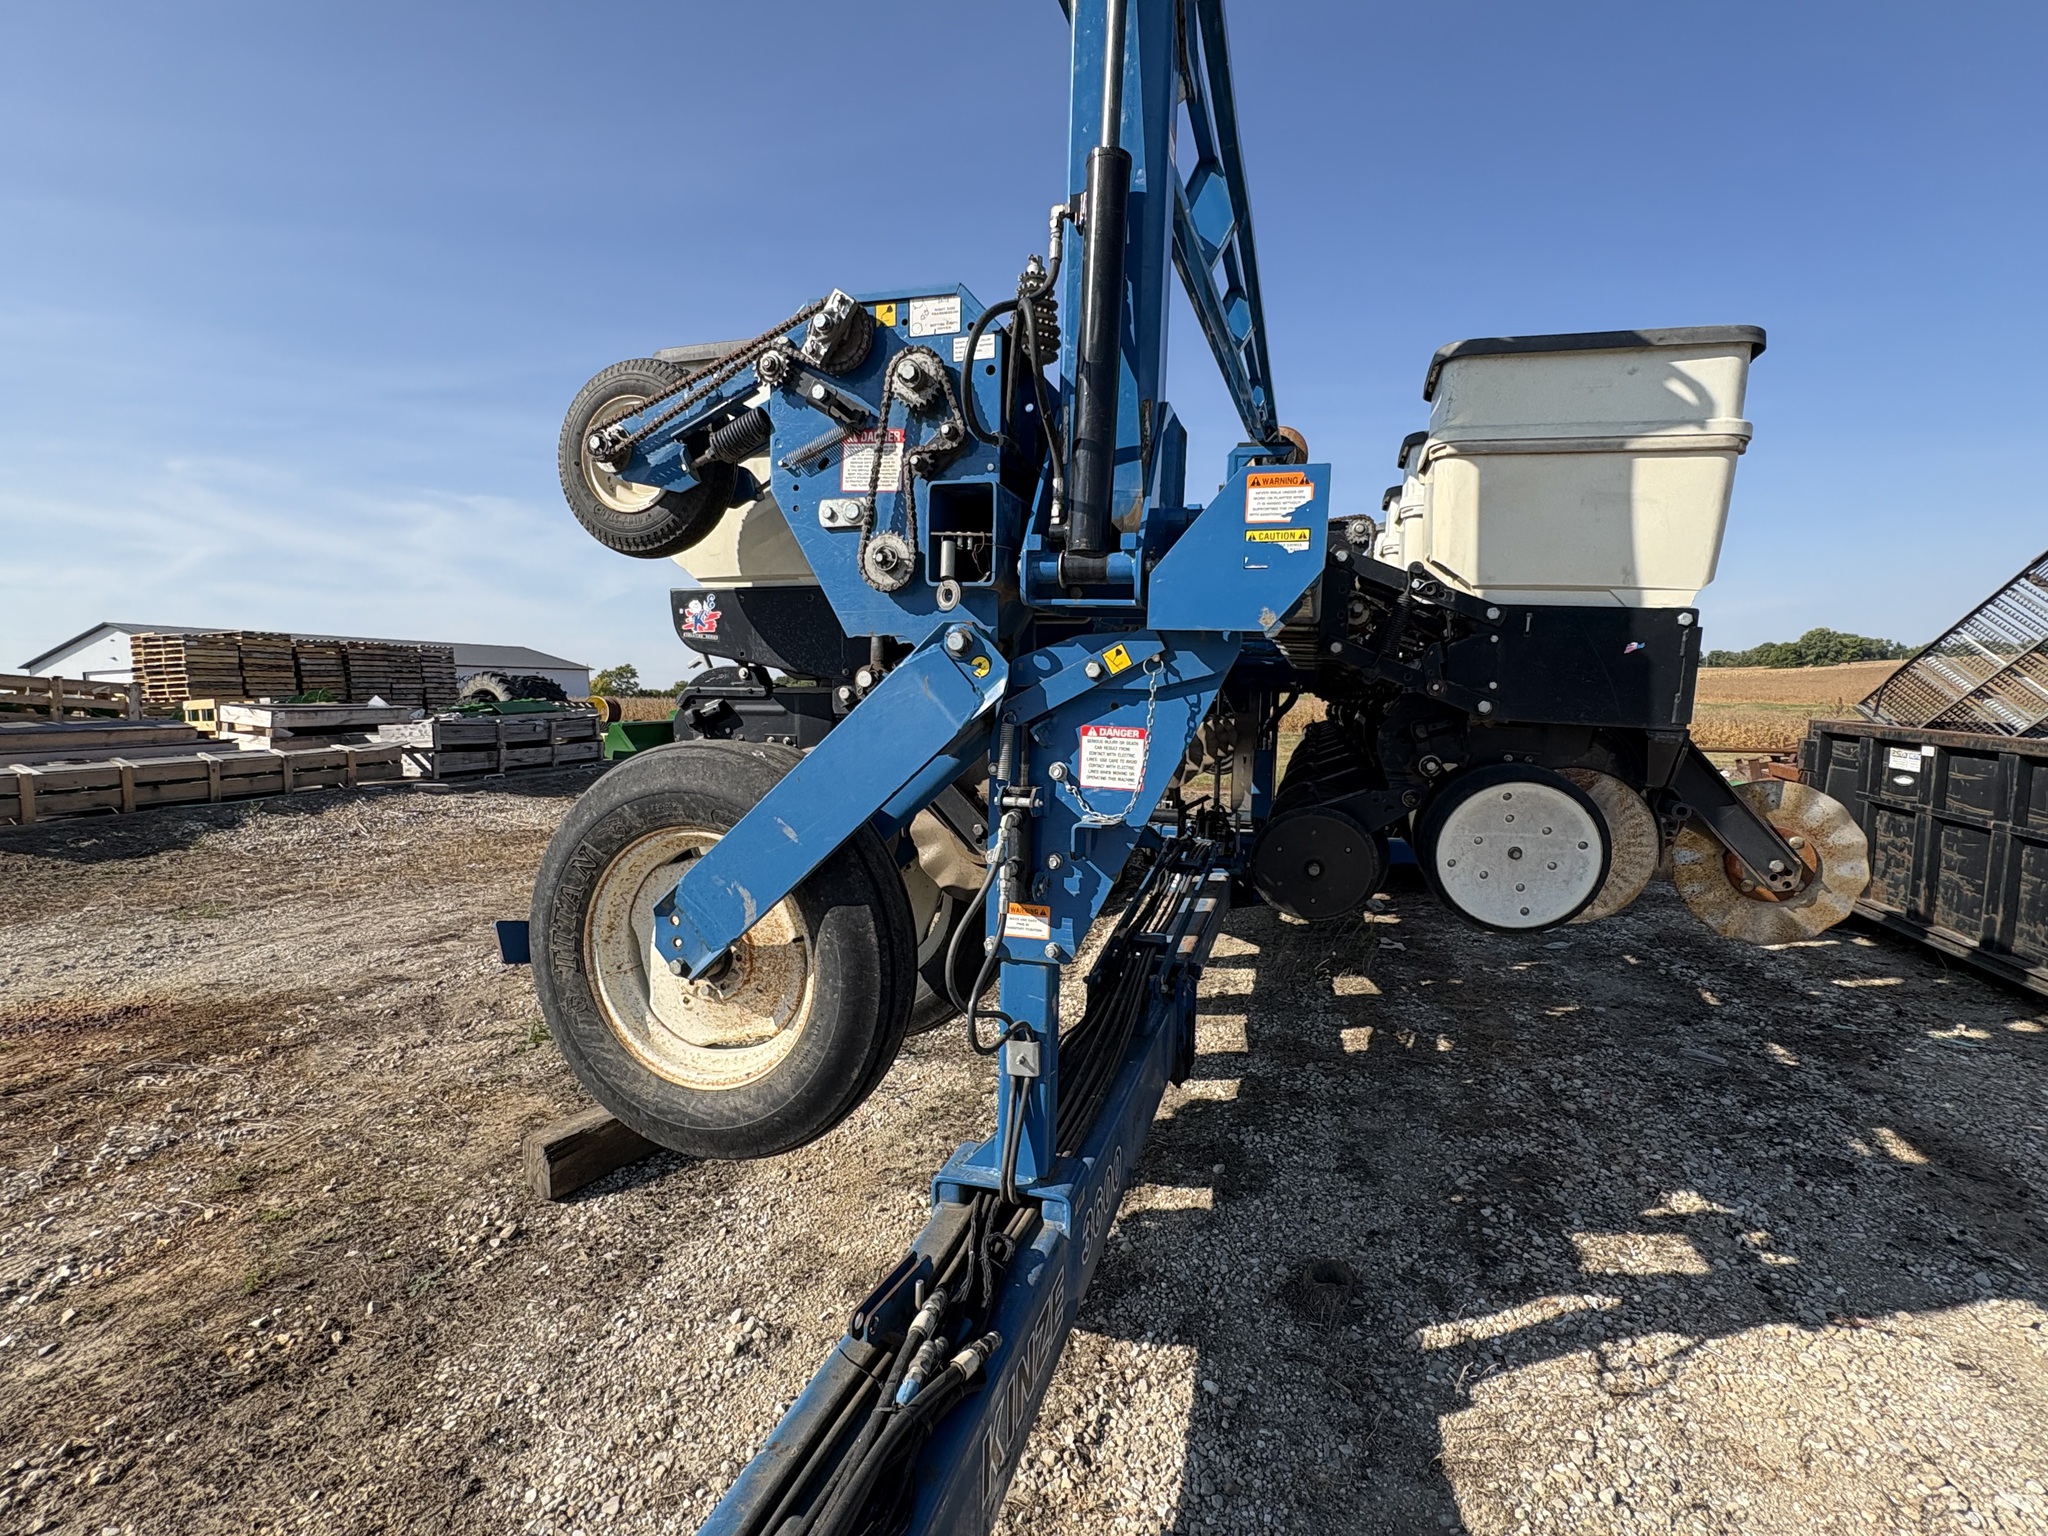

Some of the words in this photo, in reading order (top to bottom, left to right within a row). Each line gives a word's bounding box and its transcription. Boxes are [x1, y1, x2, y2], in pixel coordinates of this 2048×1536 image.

[861, 431, 901, 442] DAER
[1262, 477, 1298, 485] WARNING
[1258, 532, 1296, 540] CAUTION
[1099, 728, 1140, 738] DANGER
[1081, 1145, 1123, 1266] 3600
[981, 1266, 1066, 1510] KINZE
